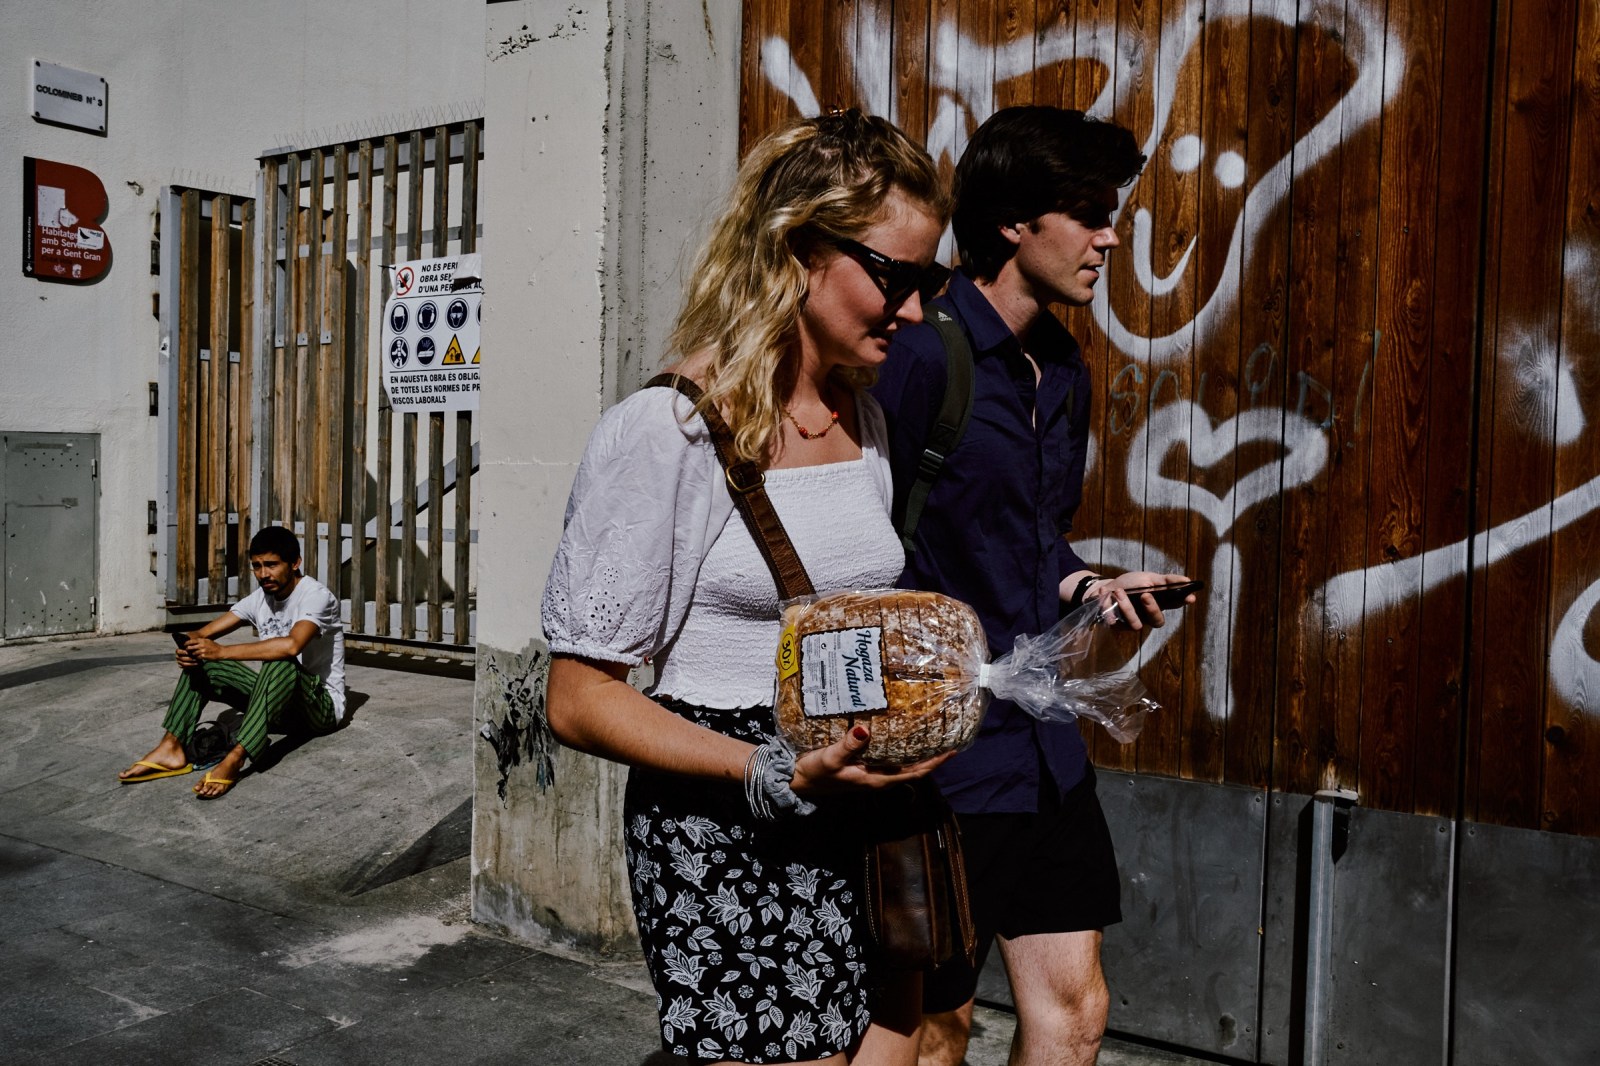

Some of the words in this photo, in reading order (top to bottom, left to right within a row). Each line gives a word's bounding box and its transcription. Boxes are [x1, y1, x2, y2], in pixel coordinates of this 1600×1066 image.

[36, 84, 83, 102] COLOMINES
[41, 237, 59, 245] amb
[64, 249, 81, 258] Gent
[84, 252, 101, 261] Gran
[433, 262, 440, 271] ÉS
[420, 274, 438, 282] OBRA
[418, 285, 438, 293] D'UNA
[400, 374, 428, 383] AQUESTA
[448, 372, 456, 381] ÉS
[421, 385, 432, 393] LES
[434, 384, 459, 393] NORMES
[415, 396, 446, 404] LABORALS
[855, 630, 874, 683] Hogaza
[842, 654, 866, 707] Natural
